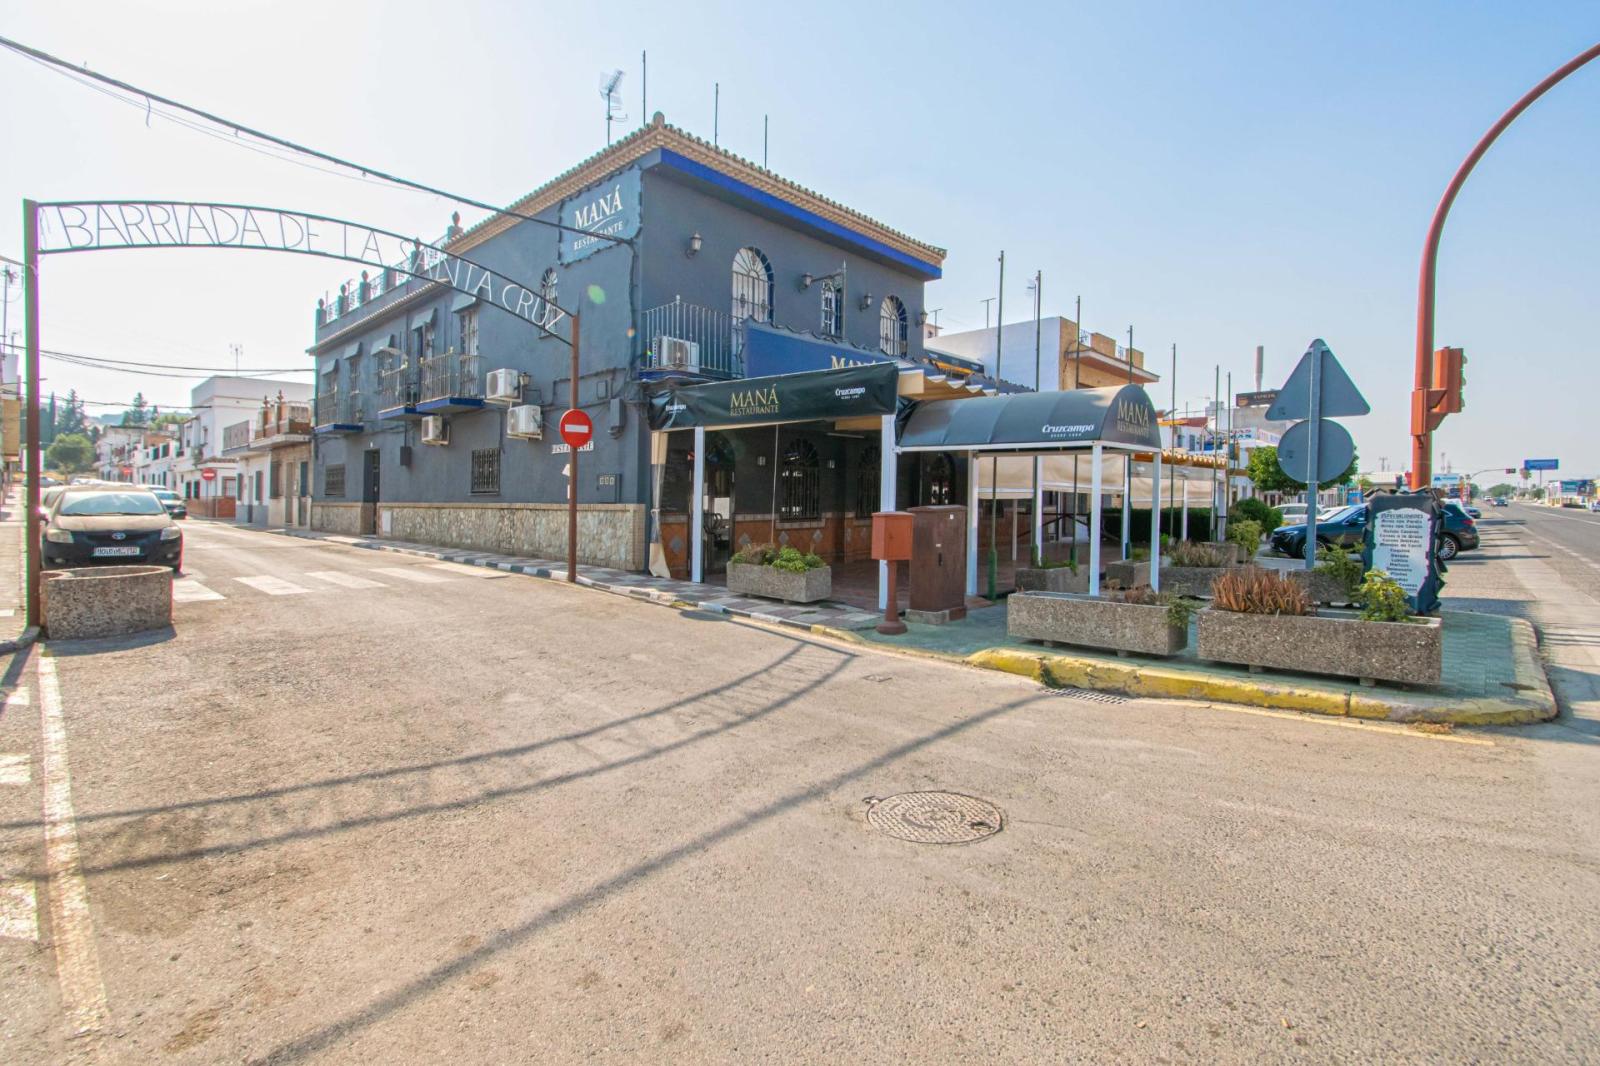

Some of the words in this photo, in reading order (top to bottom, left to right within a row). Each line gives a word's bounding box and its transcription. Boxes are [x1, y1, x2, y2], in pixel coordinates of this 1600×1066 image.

[575, 184, 623, 229] MANÁ
[574, 221, 624, 251] RESTAANTE
[57, 201, 268, 248] BARRIADA
[279, 210, 321, 252] DE
[502, 283, 566, 335] CRUZ
[730, 383, 779, 408] MANÁ
[730, 404, 779, 417] RESTAURANTE
[1042, 423, 1095, 433] Cruzcampo
